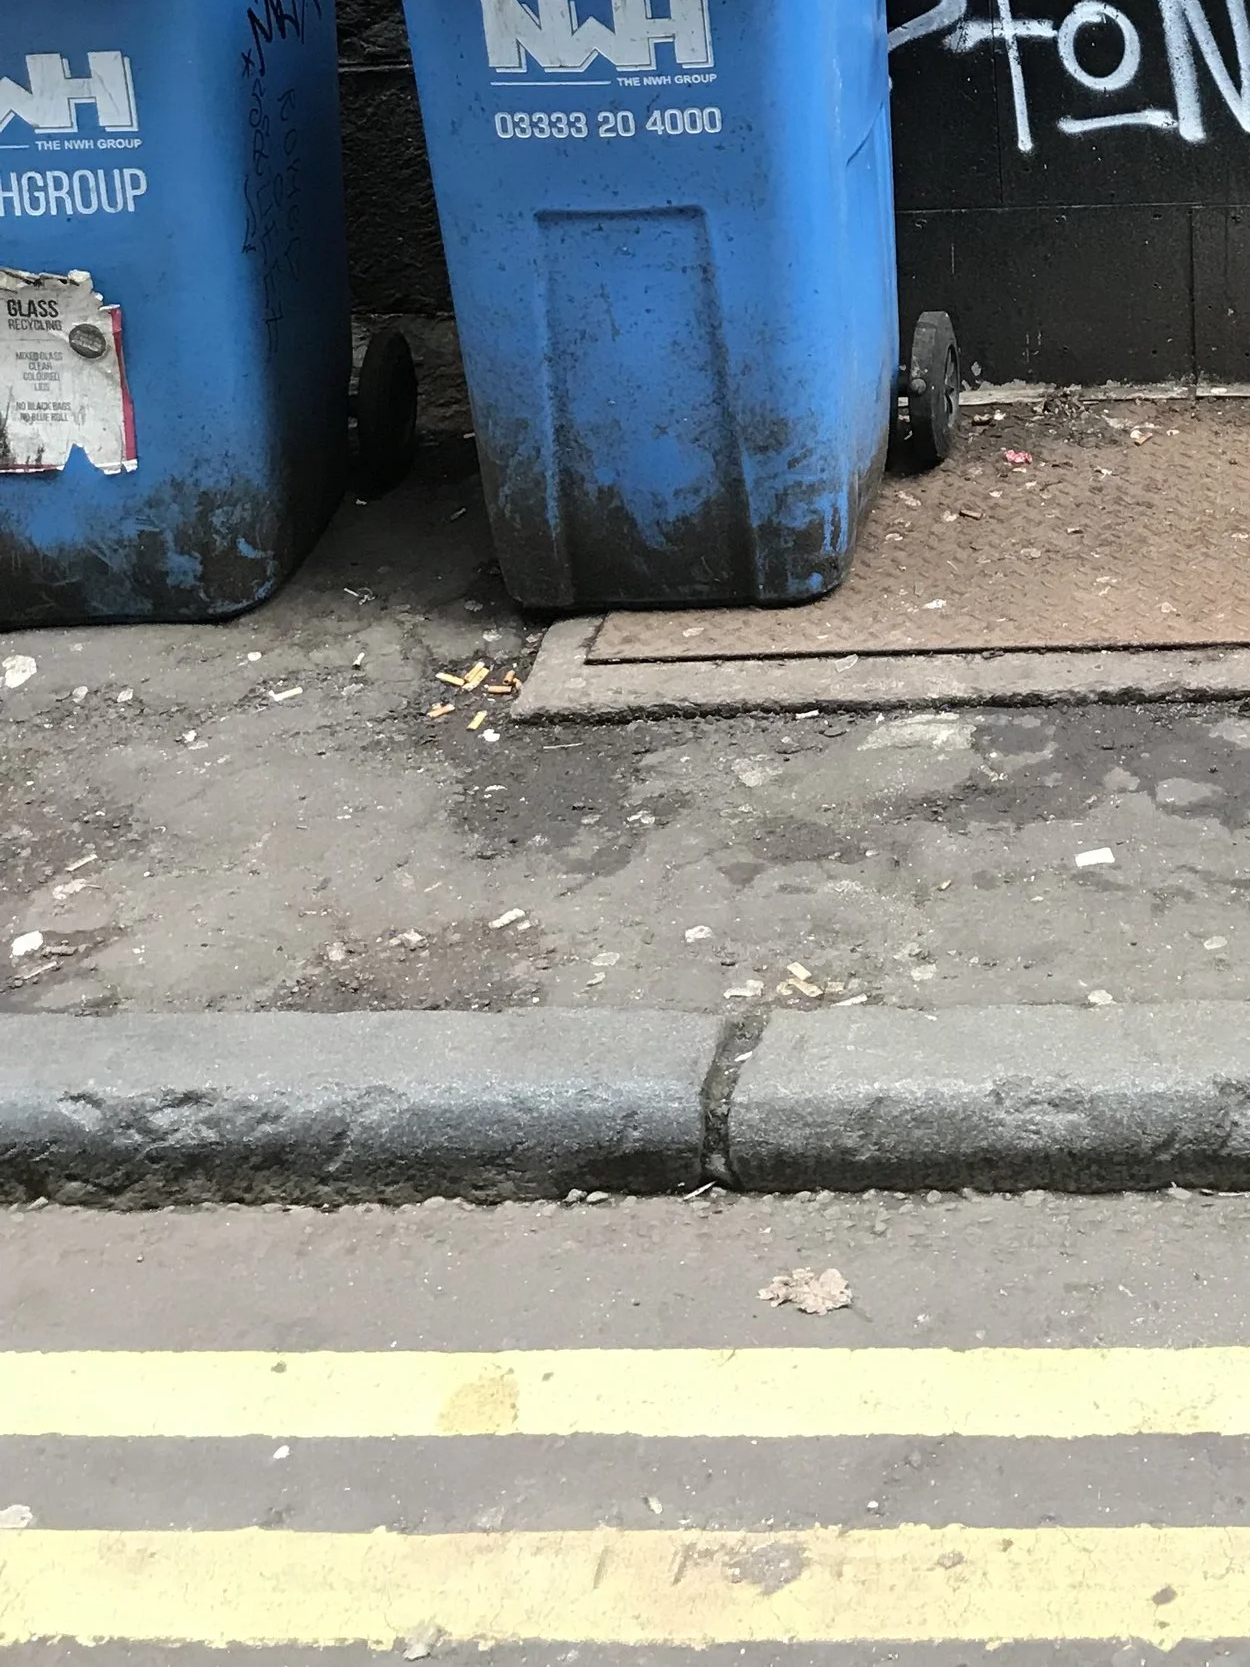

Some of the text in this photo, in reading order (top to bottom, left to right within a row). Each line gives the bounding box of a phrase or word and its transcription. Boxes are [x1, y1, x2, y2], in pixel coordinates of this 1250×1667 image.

[617, 74, 717, 87] THE NWH GROUP
[494, 106, 722, 139] 03333 20 4000
[35, 139, 143, 151] THE NWH GROUP
[7, 299, 60, 318] GLASS
[8, 318, 62, 332] RECYCLING
[27, 401, 51, 411] BLACK
